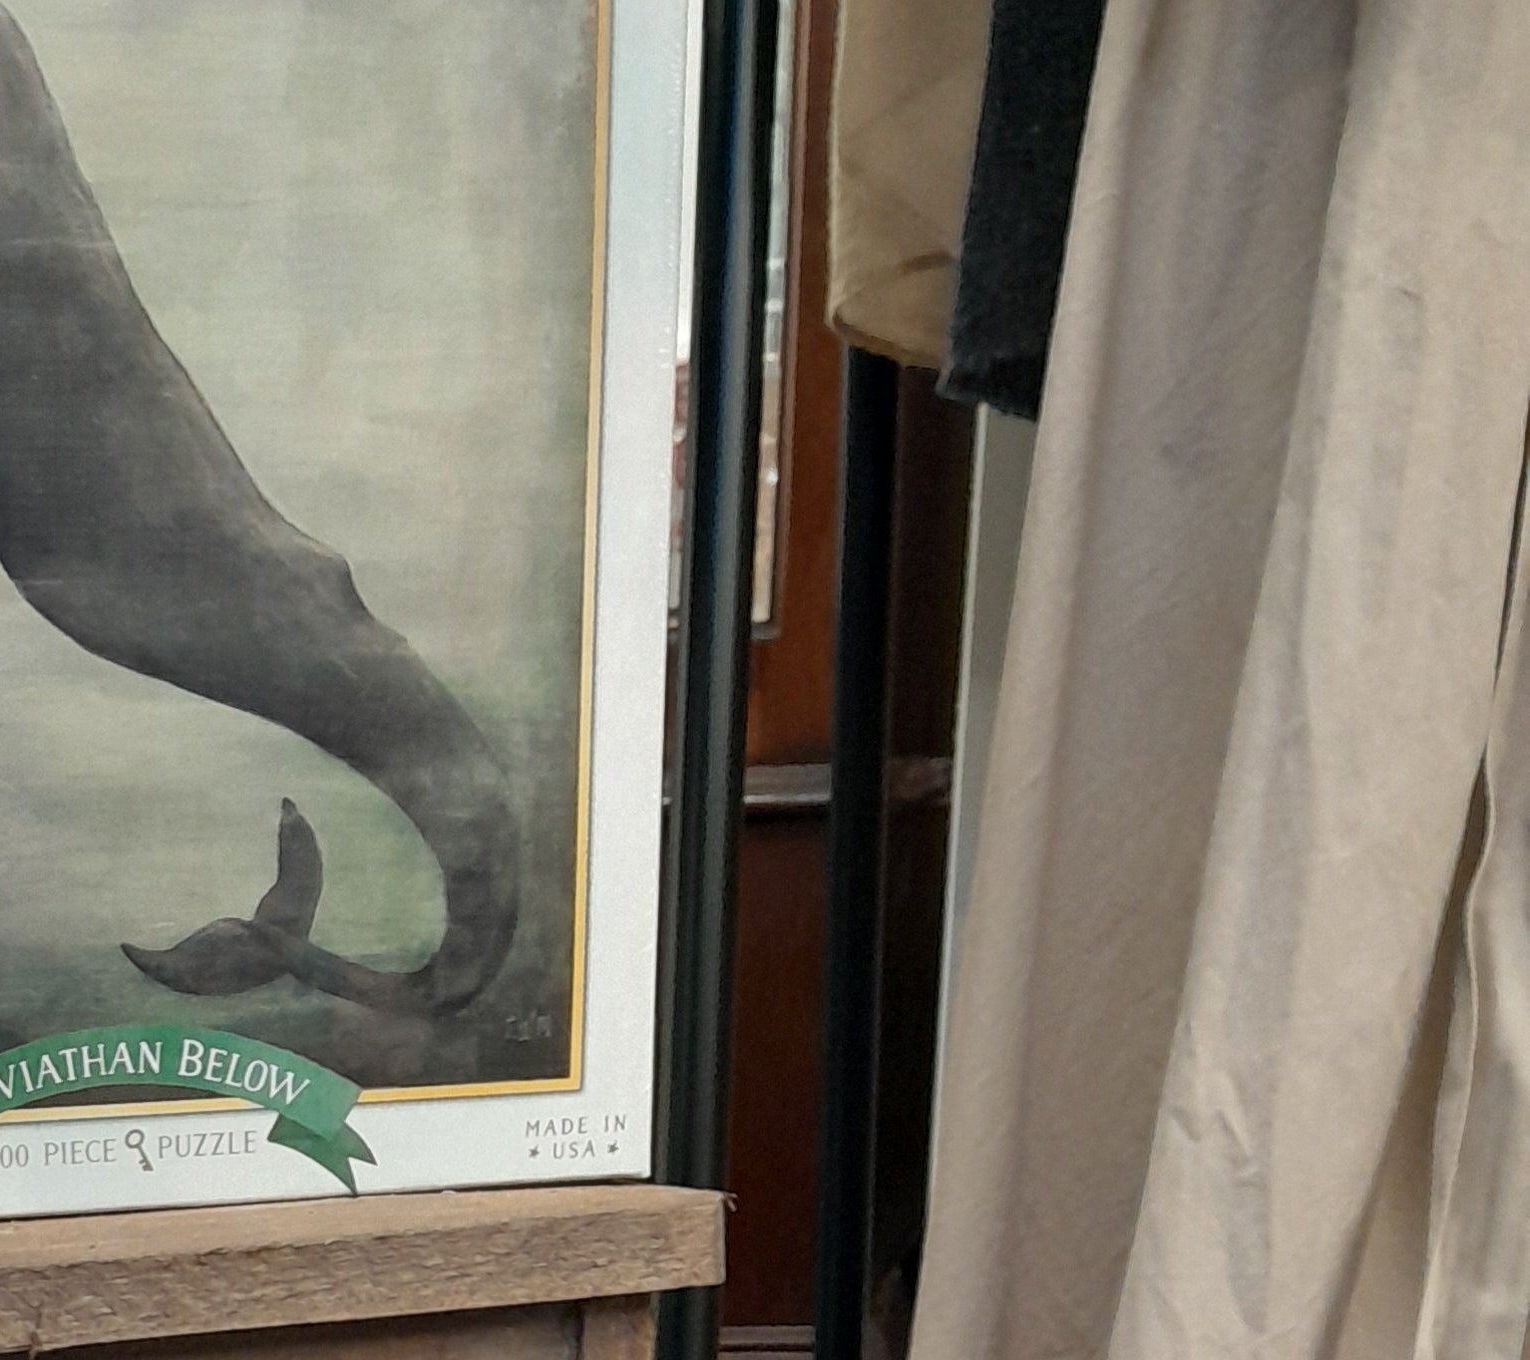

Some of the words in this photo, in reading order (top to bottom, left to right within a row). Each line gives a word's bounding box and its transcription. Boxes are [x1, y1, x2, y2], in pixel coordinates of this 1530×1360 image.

[177, 1039, 311, 1105] BELOW
[525, 1117, 589, 1137] MADE
[604, 1114, 627, 1132] IN
[43, 1140, 118, 1167] PIECE
[157, 1130, 258, 1160] PUZZLE
[552, 1142, 596, 1159] USA
